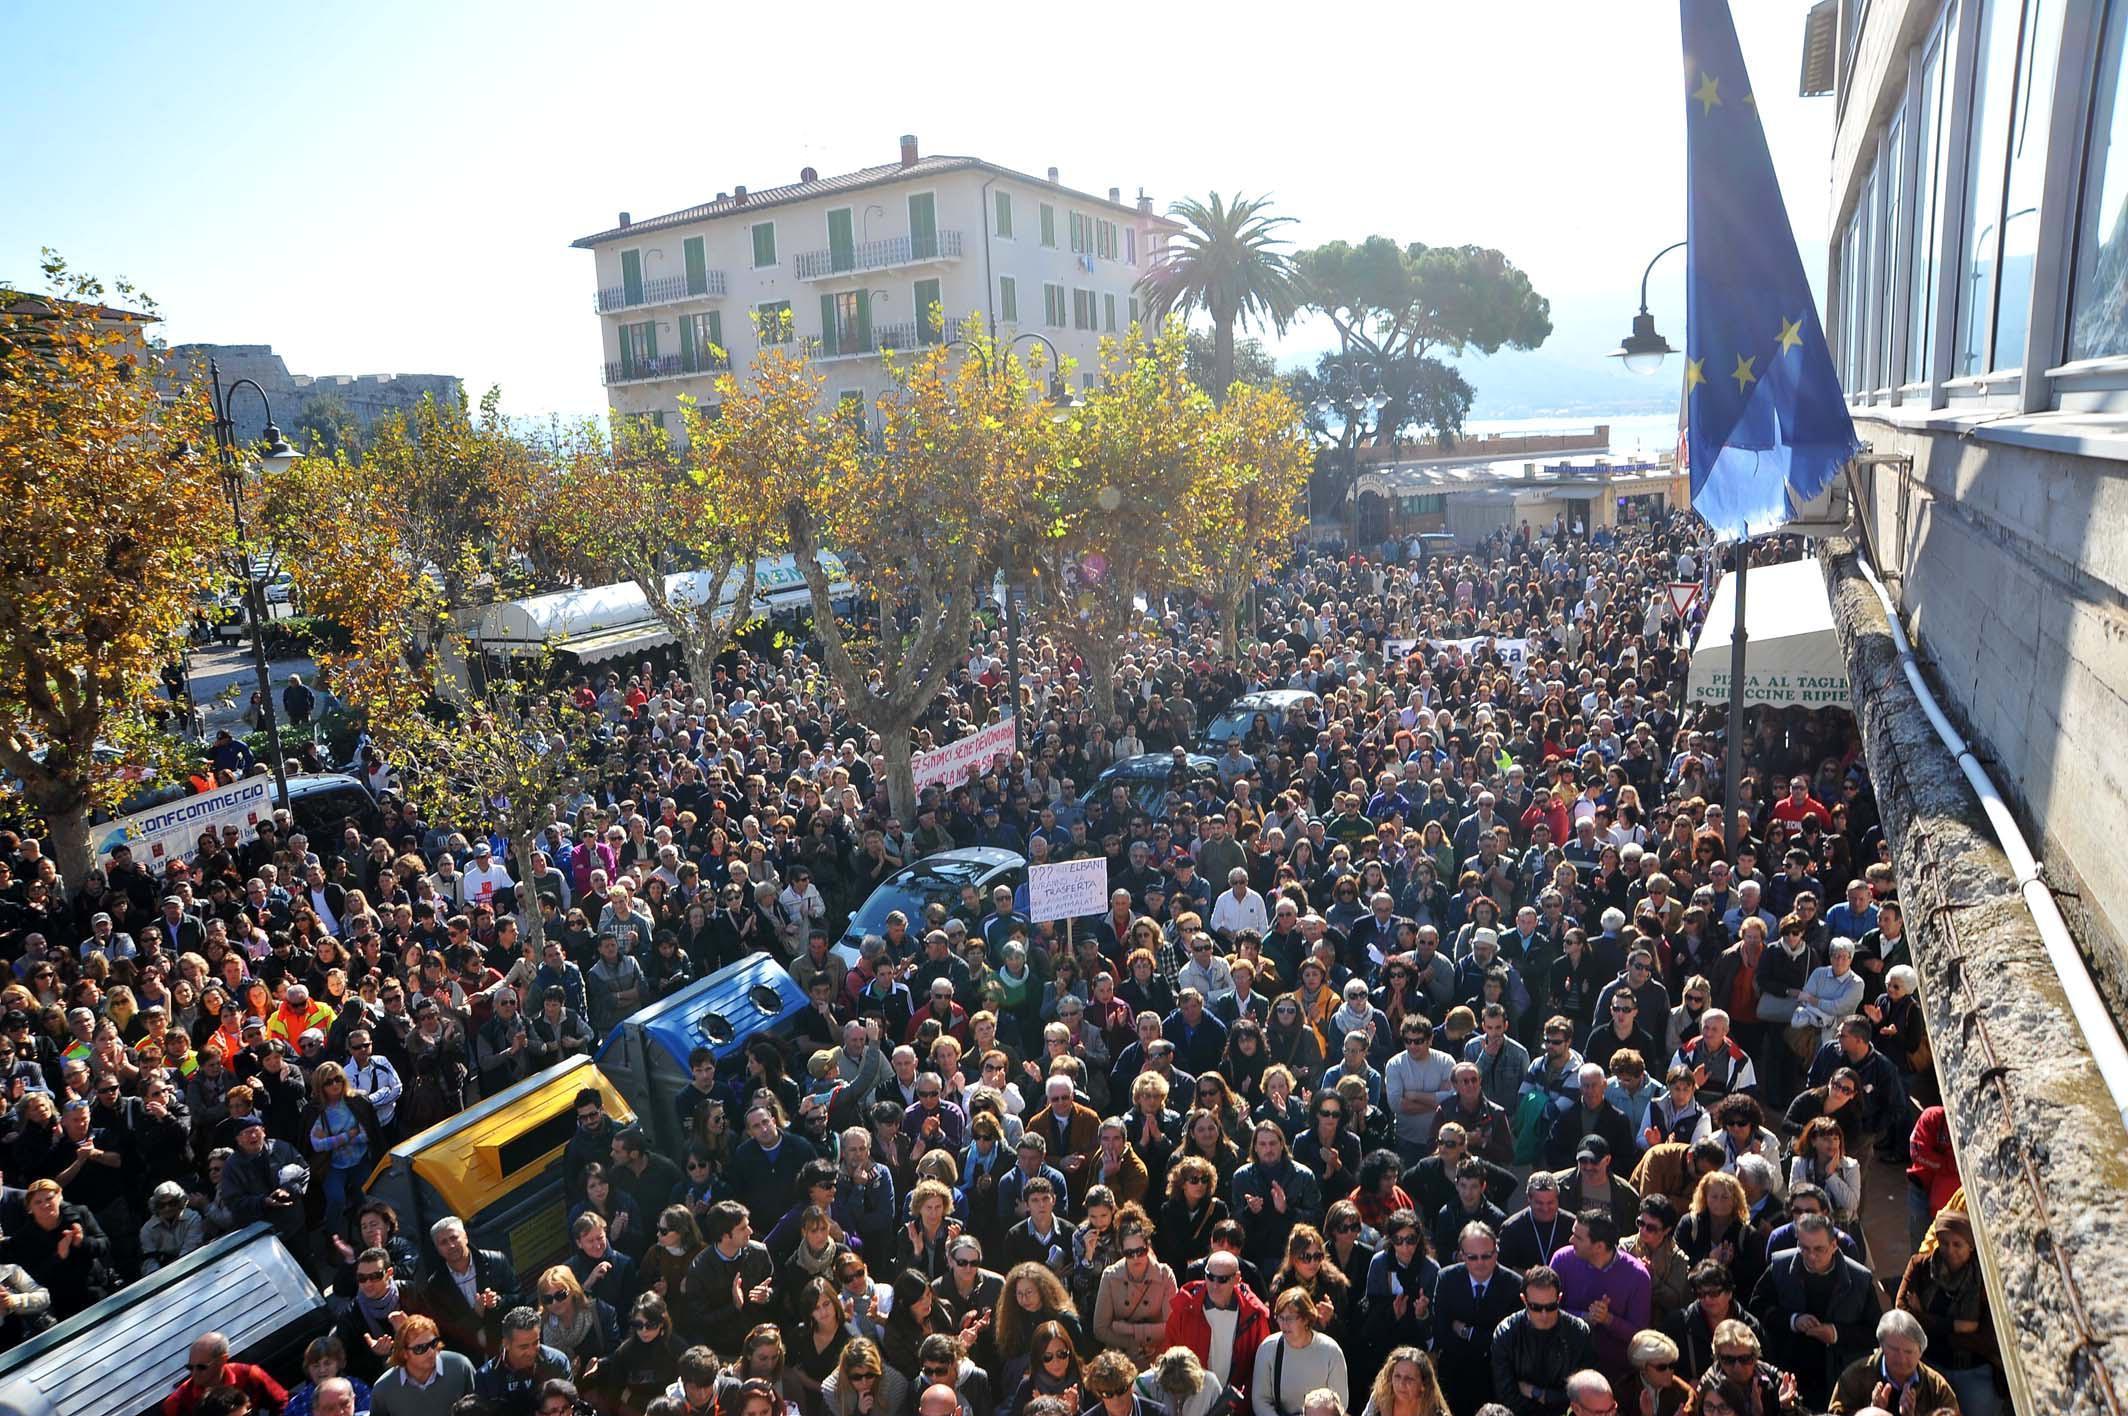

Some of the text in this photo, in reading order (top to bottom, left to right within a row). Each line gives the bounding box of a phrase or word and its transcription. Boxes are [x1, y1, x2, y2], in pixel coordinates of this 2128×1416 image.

[1471, 641, 1521, 662] Csa
[1712, 674, 1760, 687] PIA
[1767, 676, 1790, 688] AL
[1696, 687, 1796, 700] SCHCCINE
[1070, 859, 1103, 873] ELBANI
[1045, 880, 1097, 897] TRASFERTA
